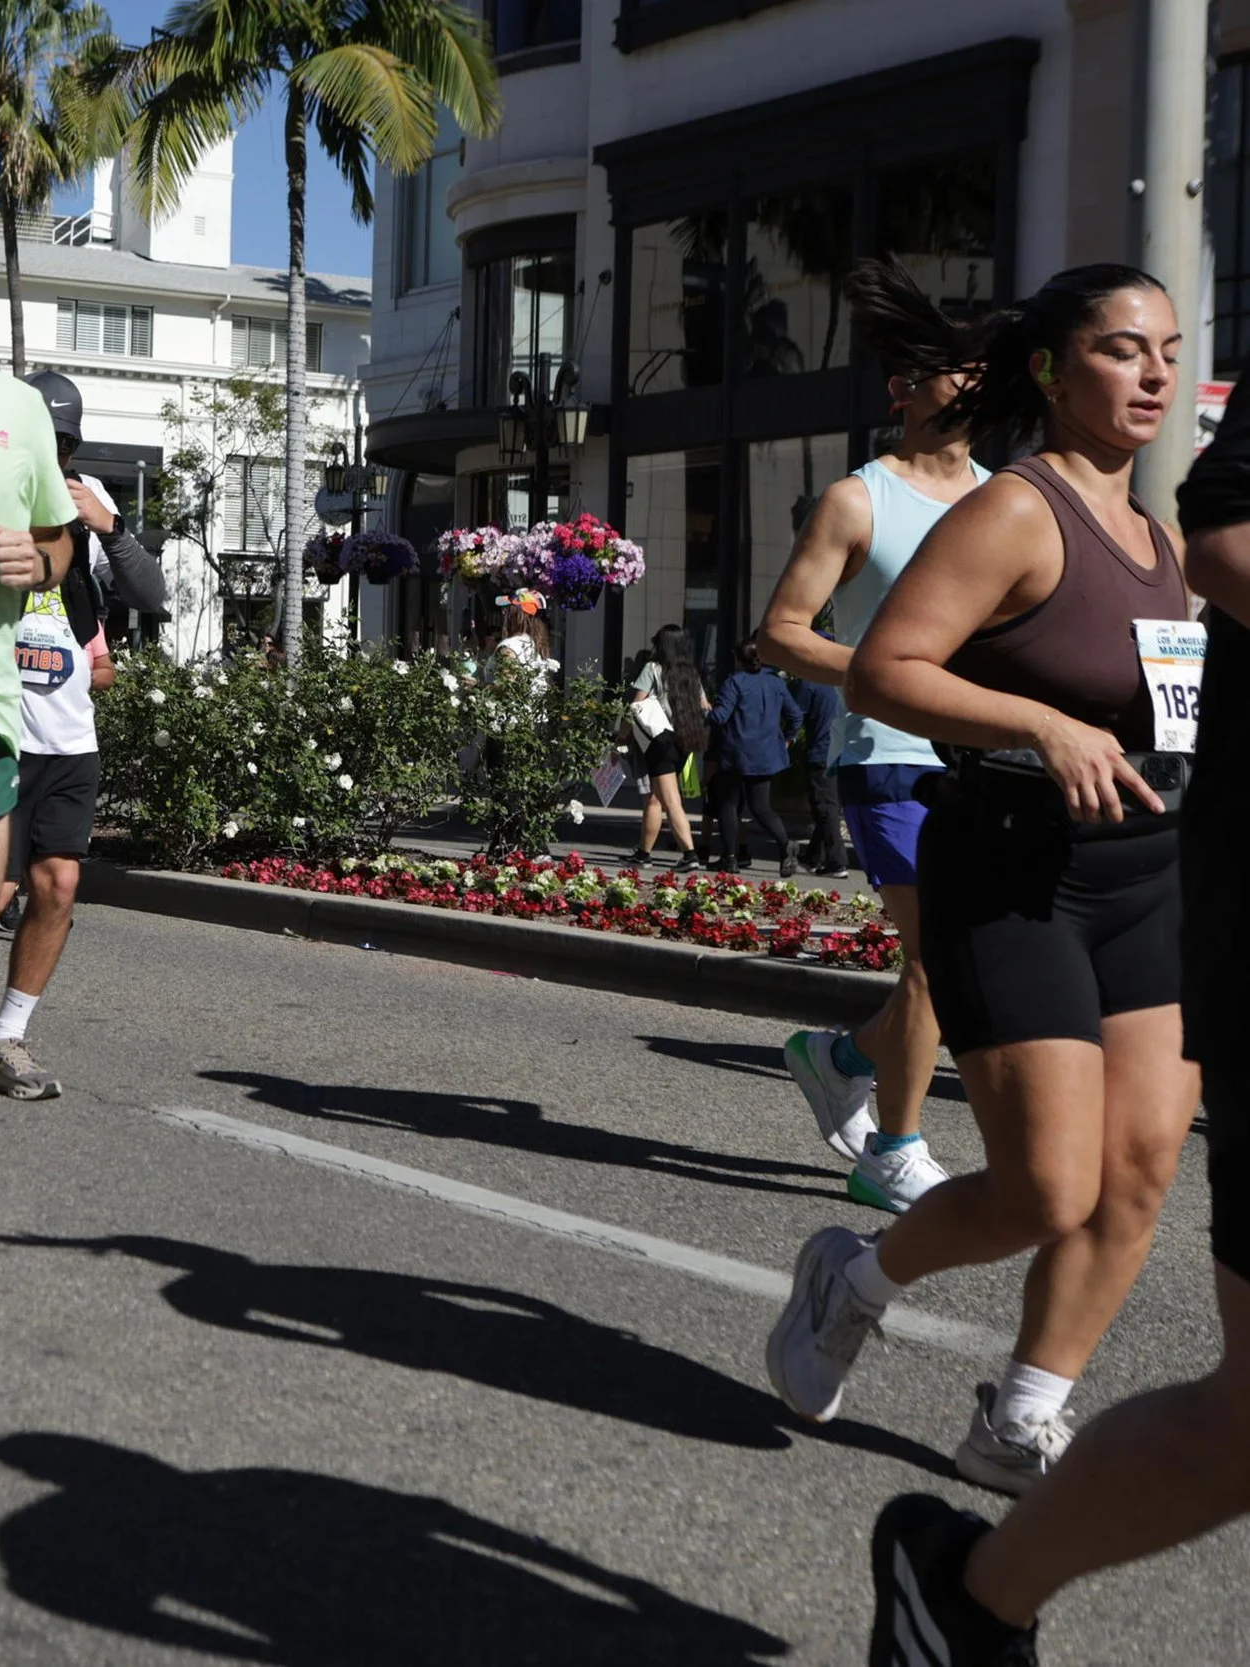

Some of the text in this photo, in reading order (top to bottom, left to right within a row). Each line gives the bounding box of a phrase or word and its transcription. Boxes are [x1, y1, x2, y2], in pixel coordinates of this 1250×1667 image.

[1156, 635, 1207, 647] LOS ANGELE
[1158, 645, 1207, 658] MARATHO
